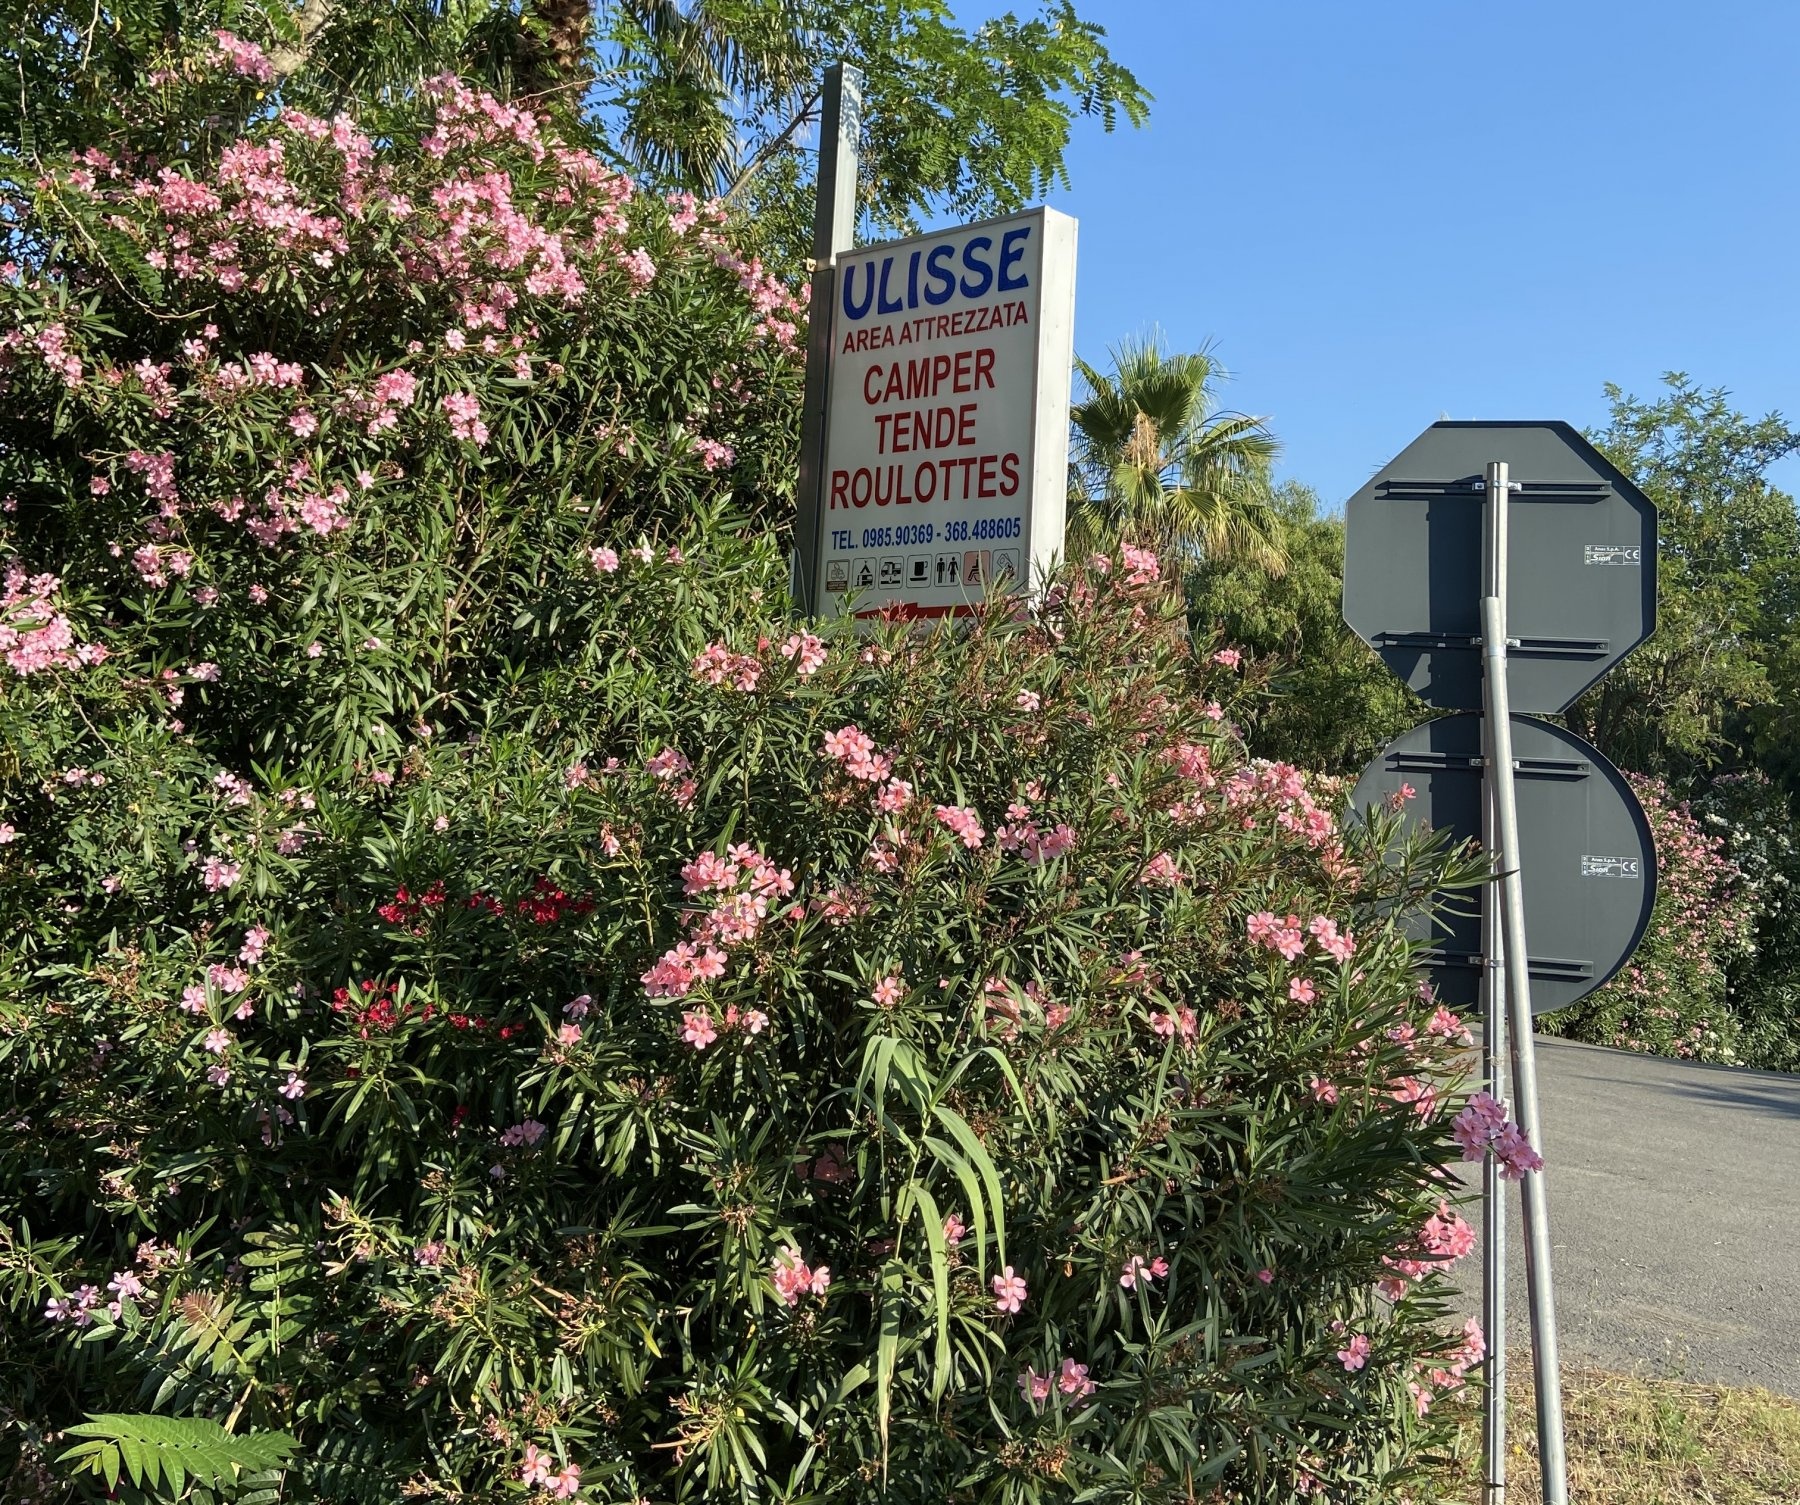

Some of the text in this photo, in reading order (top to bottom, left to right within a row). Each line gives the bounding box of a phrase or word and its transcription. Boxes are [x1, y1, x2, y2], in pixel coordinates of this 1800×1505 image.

[842, 226, 1032, 321] ULISSE
[842, 301, 1028, 354] AREA ATTREZZATA
[863, 348, 996, 405] CAMPER
[874, 403, 978, 454] TENDE
[830, 452, 1020, 510] ROULOTTES
[832, 530, 858, 550] TEL.
[862, 523, 933, 548] 0985.90369
[944, 517, 1021, 541] 368.488605
[1624, 549, 1639, 560] CE
[1622, 861, 1637, 872] CE
